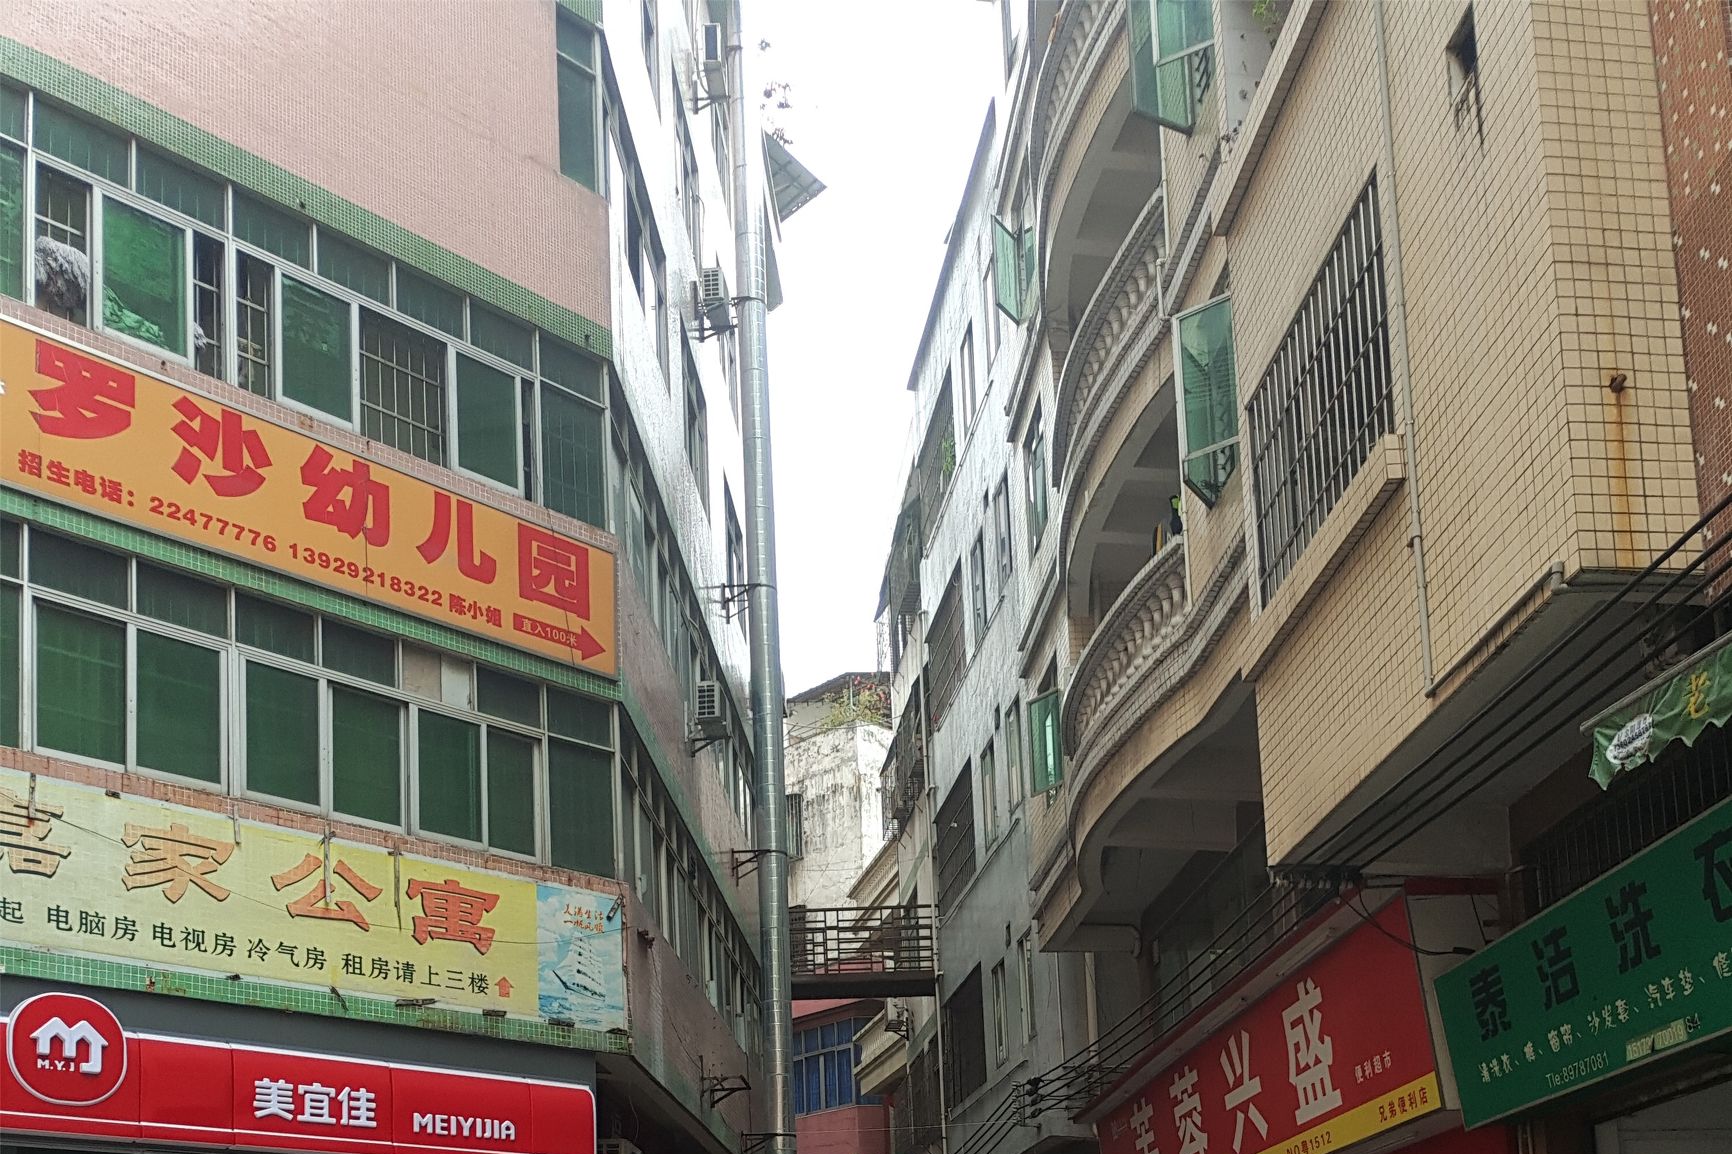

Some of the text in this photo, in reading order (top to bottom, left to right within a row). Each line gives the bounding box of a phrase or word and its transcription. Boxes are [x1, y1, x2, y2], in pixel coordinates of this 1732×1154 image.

[28, 339, 591, 620] 罗沙幼儿园
[289, 543, 443, 607] 13929218322
[449, 593, 502, 628] 陈小姐
[521, 618, 577, 648] 直入100米
[47, 904, 139, 942] 电脑房
[152, 922, 237, 957] 电视房
[247, 938, 327, 970] 冷气房
[341, 952, 490, 995] 租房请上三楼
[1354, 1050, 1392, 1084] 便利超市
[1545, 1051, 1609, 1088] Tle:89787081
[254, 1078, 516, 1142] 美宜佳 MEIYIJIA
[1378, 1086, 1428, 1123] 兄弟便利店
